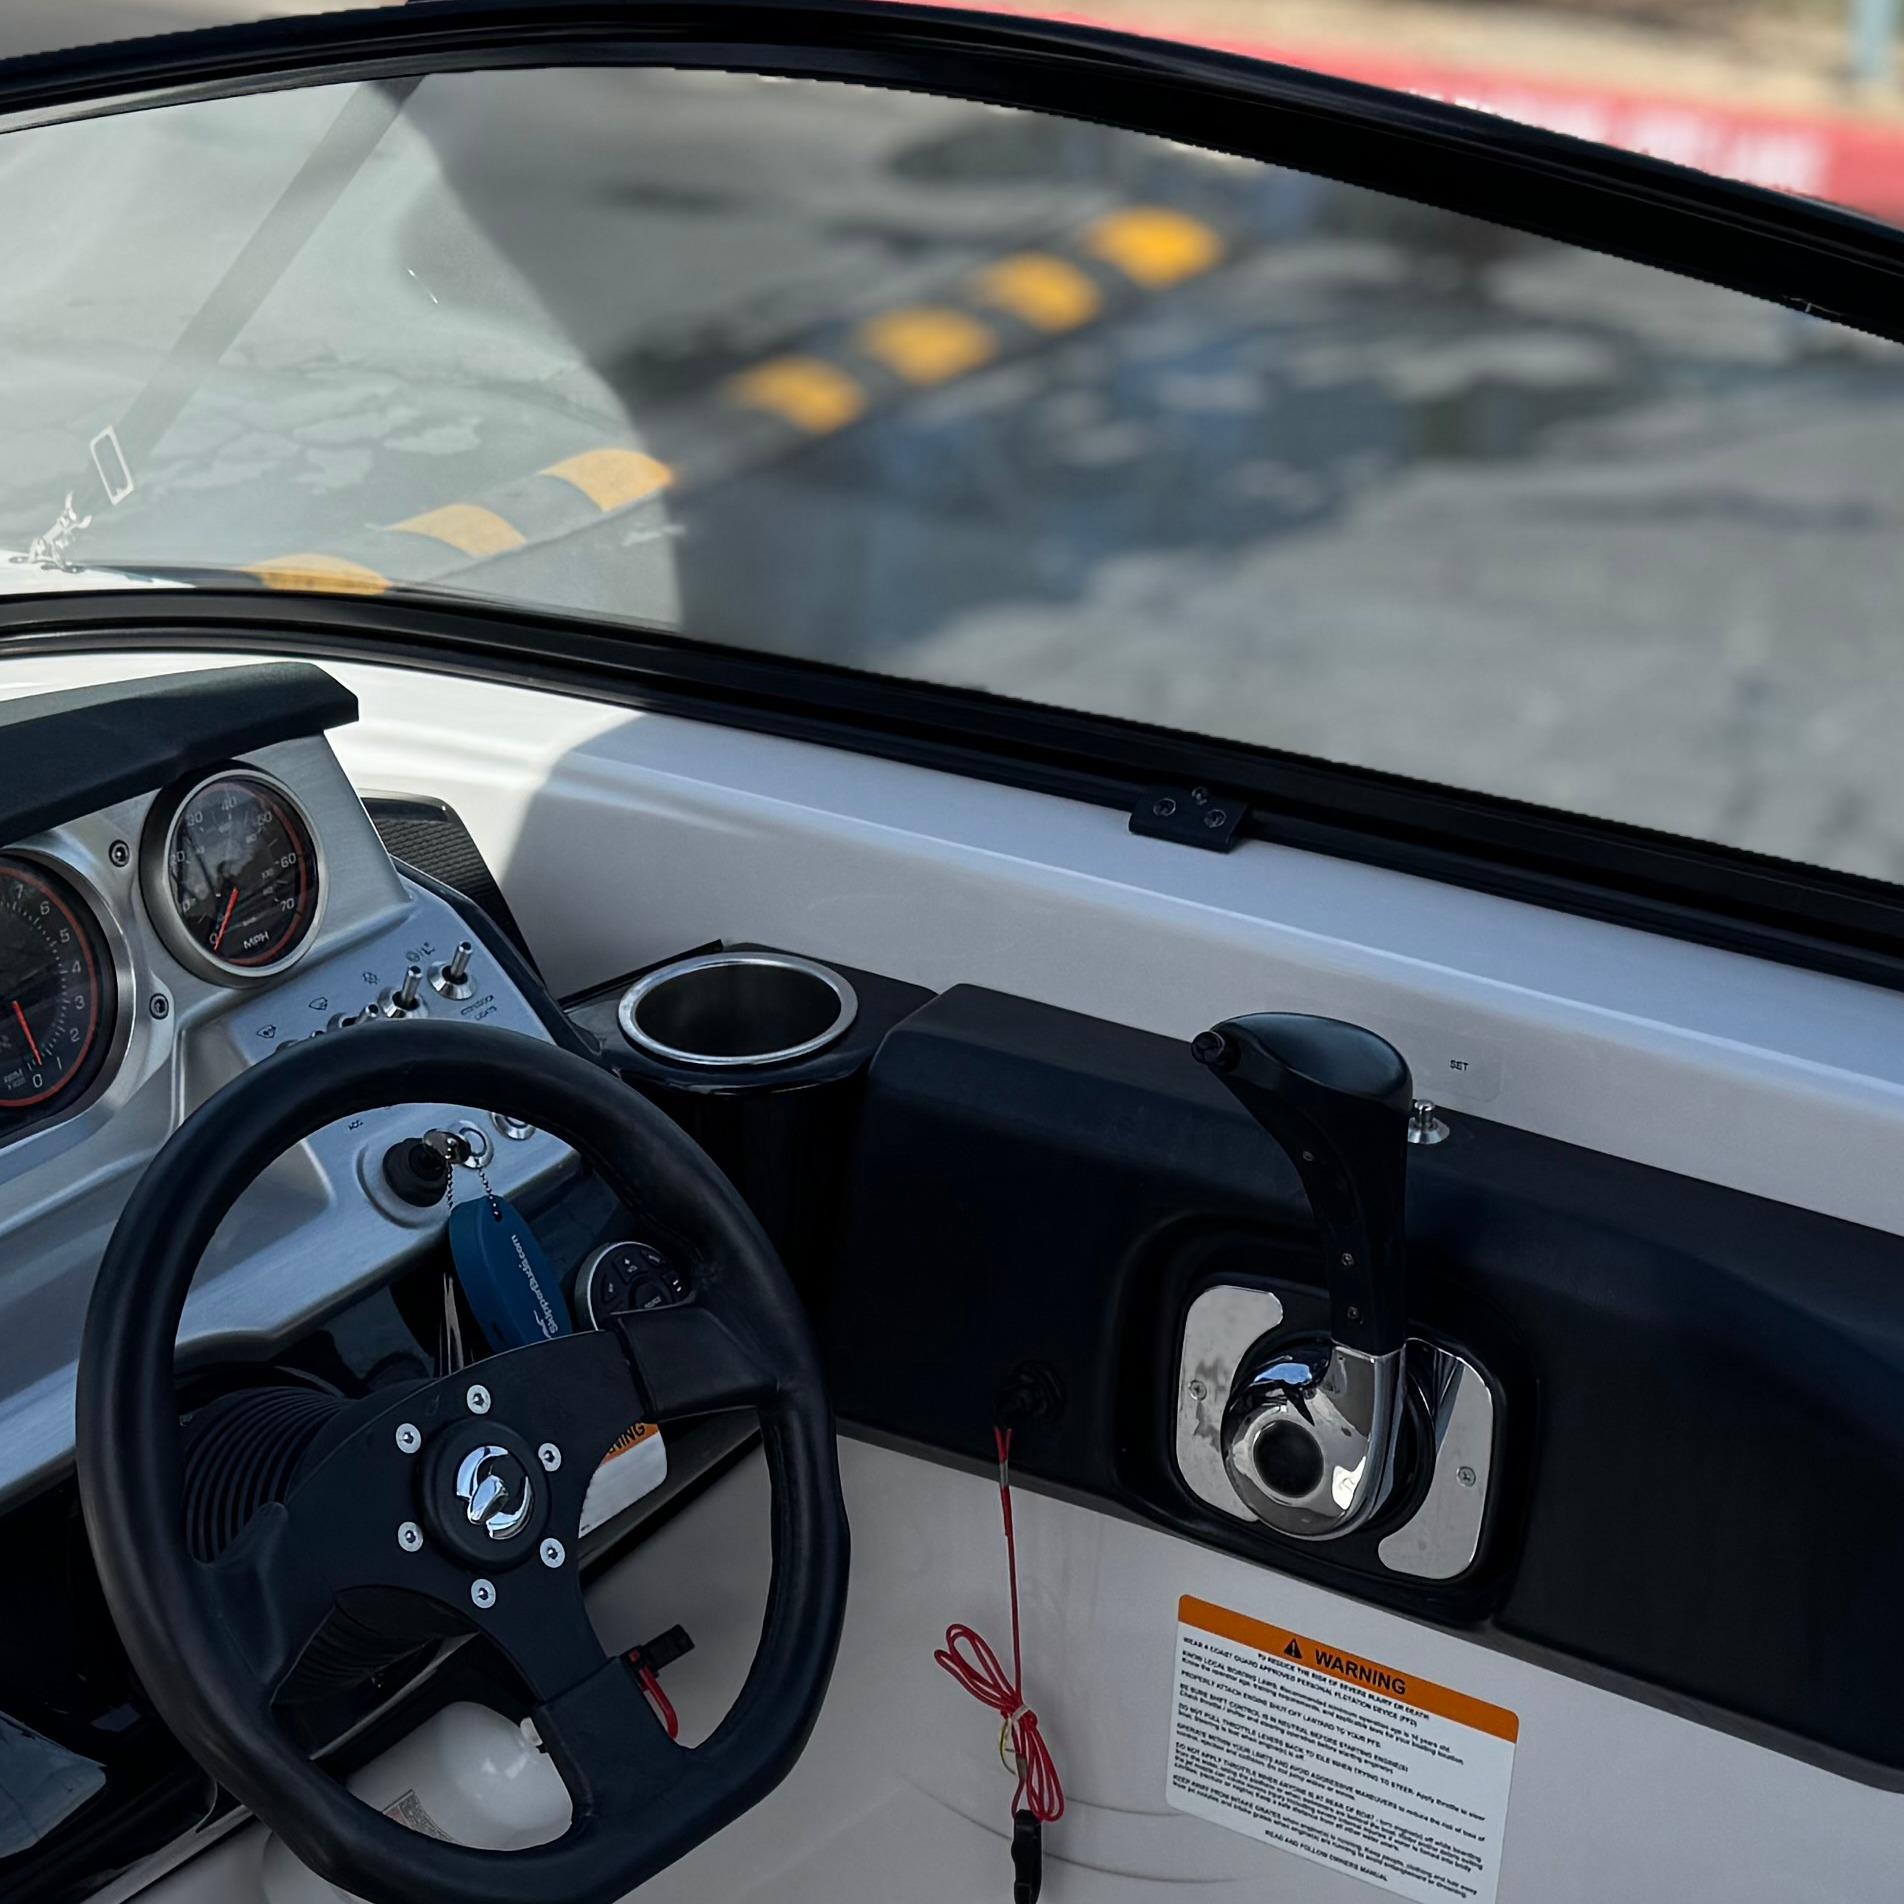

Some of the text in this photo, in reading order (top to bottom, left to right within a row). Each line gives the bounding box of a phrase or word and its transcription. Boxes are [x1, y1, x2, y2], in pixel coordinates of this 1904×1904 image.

[280, 852, 296, 868] 60
[15, 884, 24, 899] 7
[39, 901, 50, 915] 6
[280, 897, 295, 913] 70
[59, 929, 70, 943] 5
[243, 931, 269, 949] MPH
[71, 960, 82, 974] 4
[74, 995, 85, 1009] 3
[70, 1028, 81, 1043] 2
[32, 1073, 43, 1089] 0
[1315, 1649, 1406, 1695] WARNING
